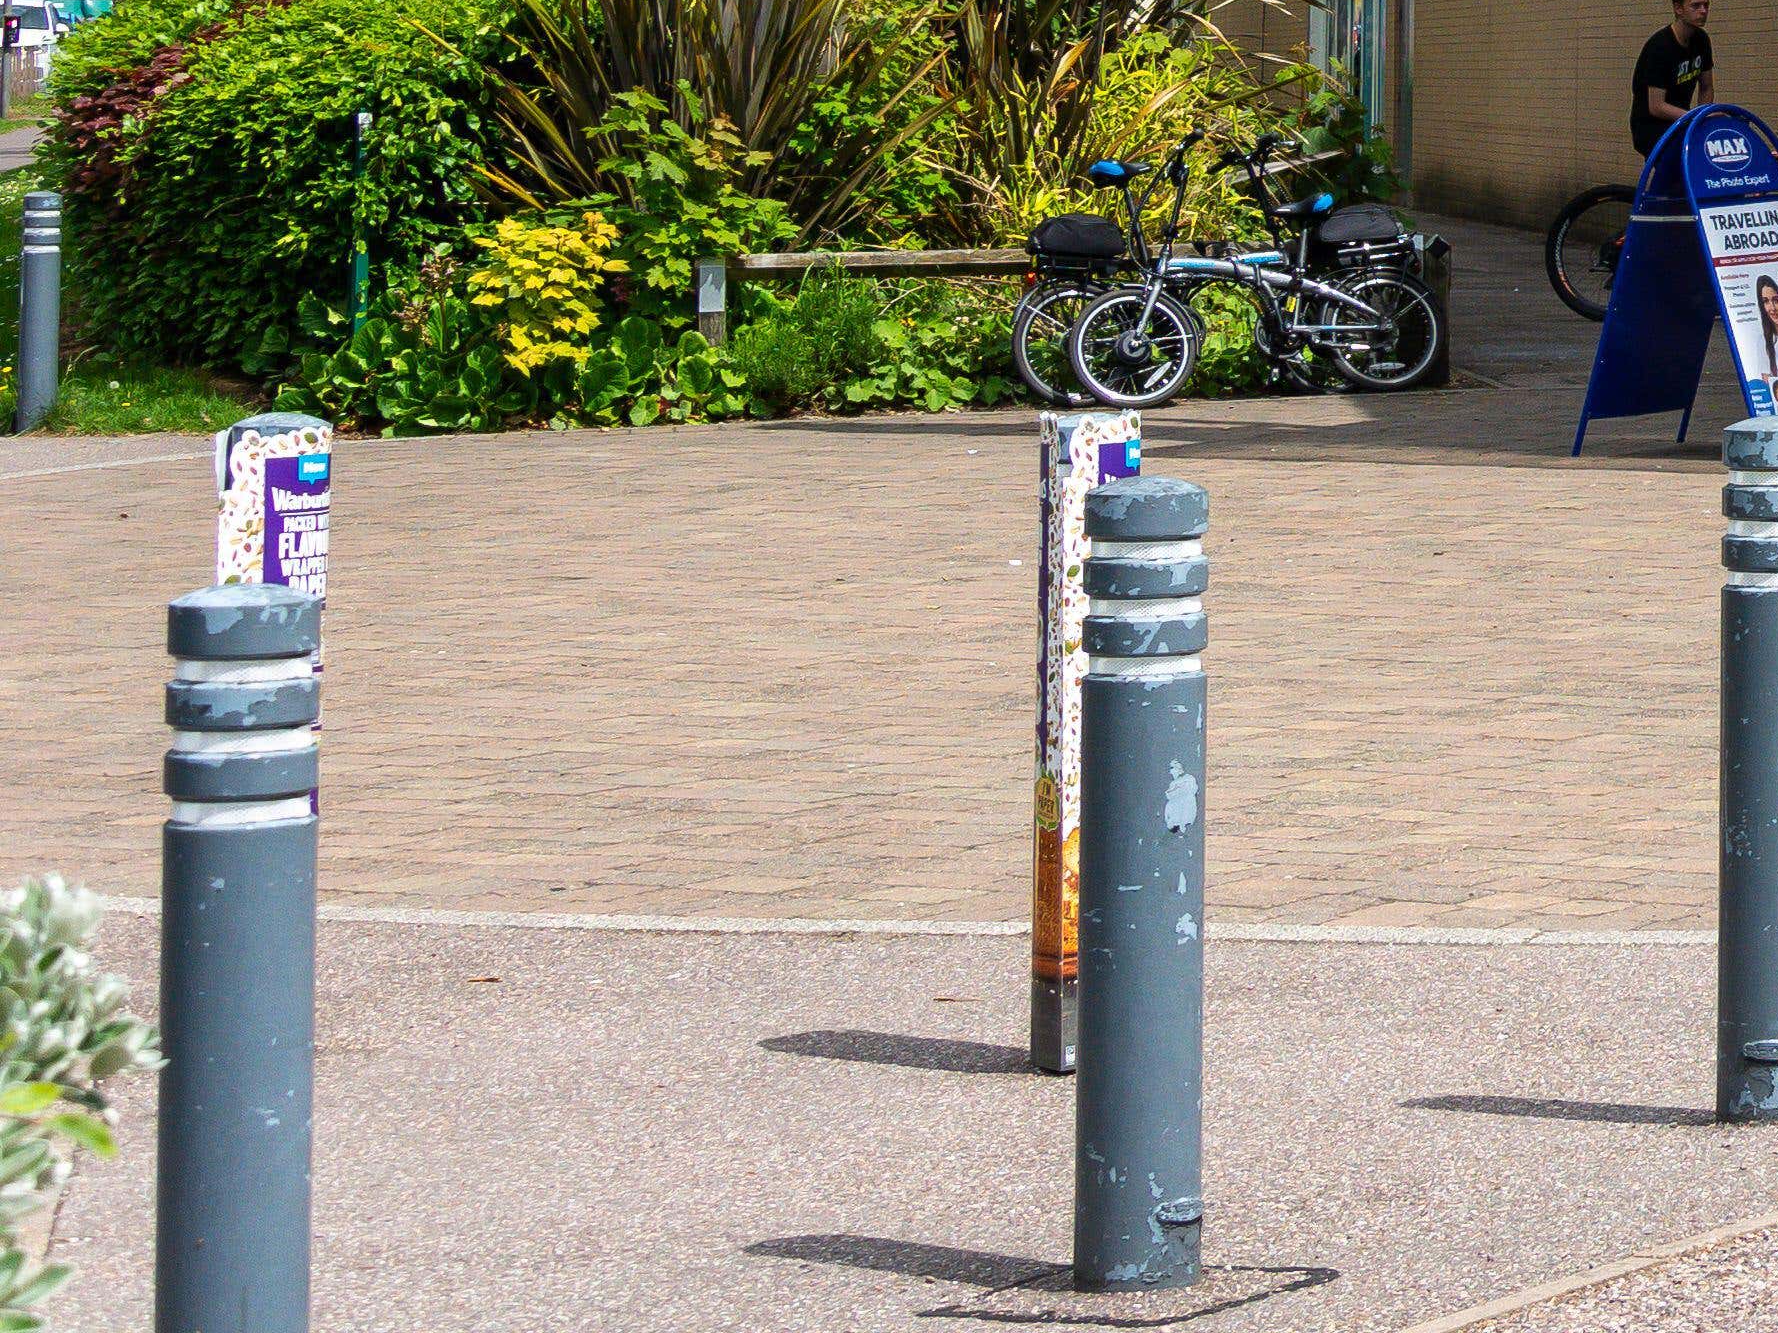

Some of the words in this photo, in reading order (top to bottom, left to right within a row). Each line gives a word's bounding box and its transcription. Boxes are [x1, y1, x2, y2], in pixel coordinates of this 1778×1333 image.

[1706, 137, 1748, 157] MAX
[1705, 178, 1720, 189] The
[1744, 173, 1770, 186] Expert
